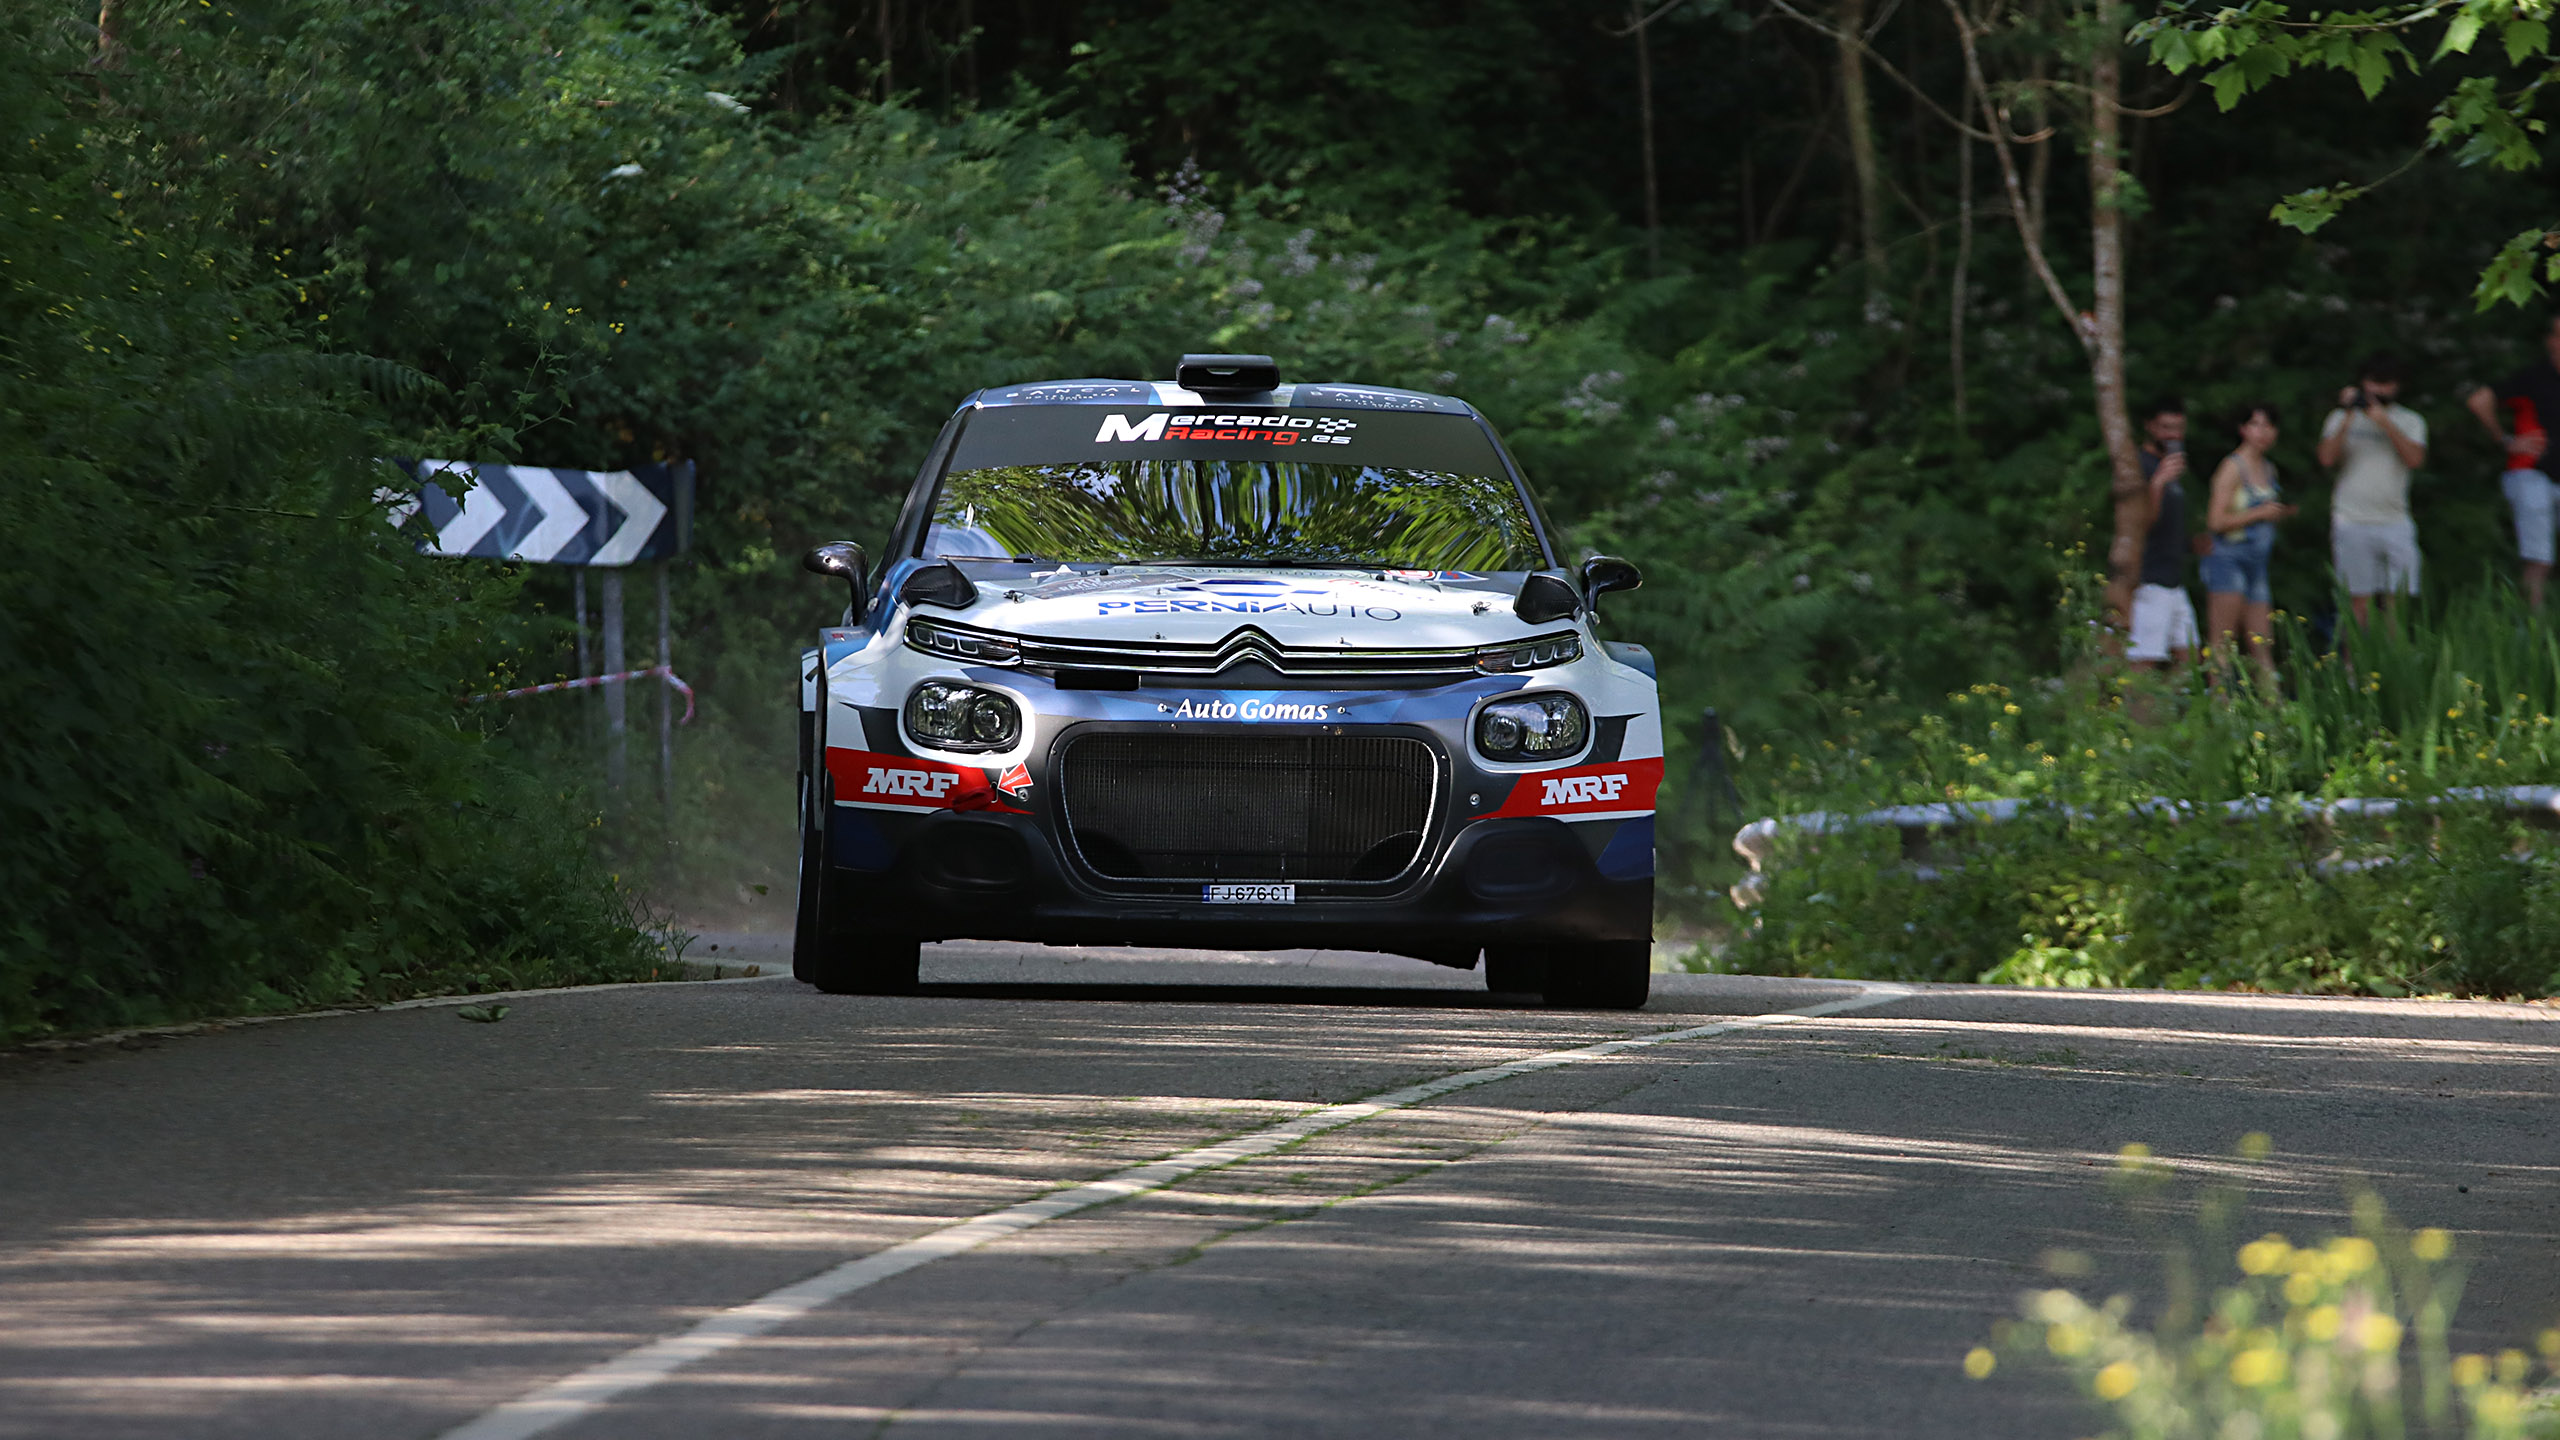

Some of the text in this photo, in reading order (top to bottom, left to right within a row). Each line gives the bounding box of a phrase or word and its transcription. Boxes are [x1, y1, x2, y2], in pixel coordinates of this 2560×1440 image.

[1095, 412, 1315, 443] Mercado
[1164, 426, 1352, 446] Racing.es
[1174, 698, 1329, 721] Auto Gomas
[862, 767, 960, 799] MRF
[1540, 773, 1629, 806] MRF
